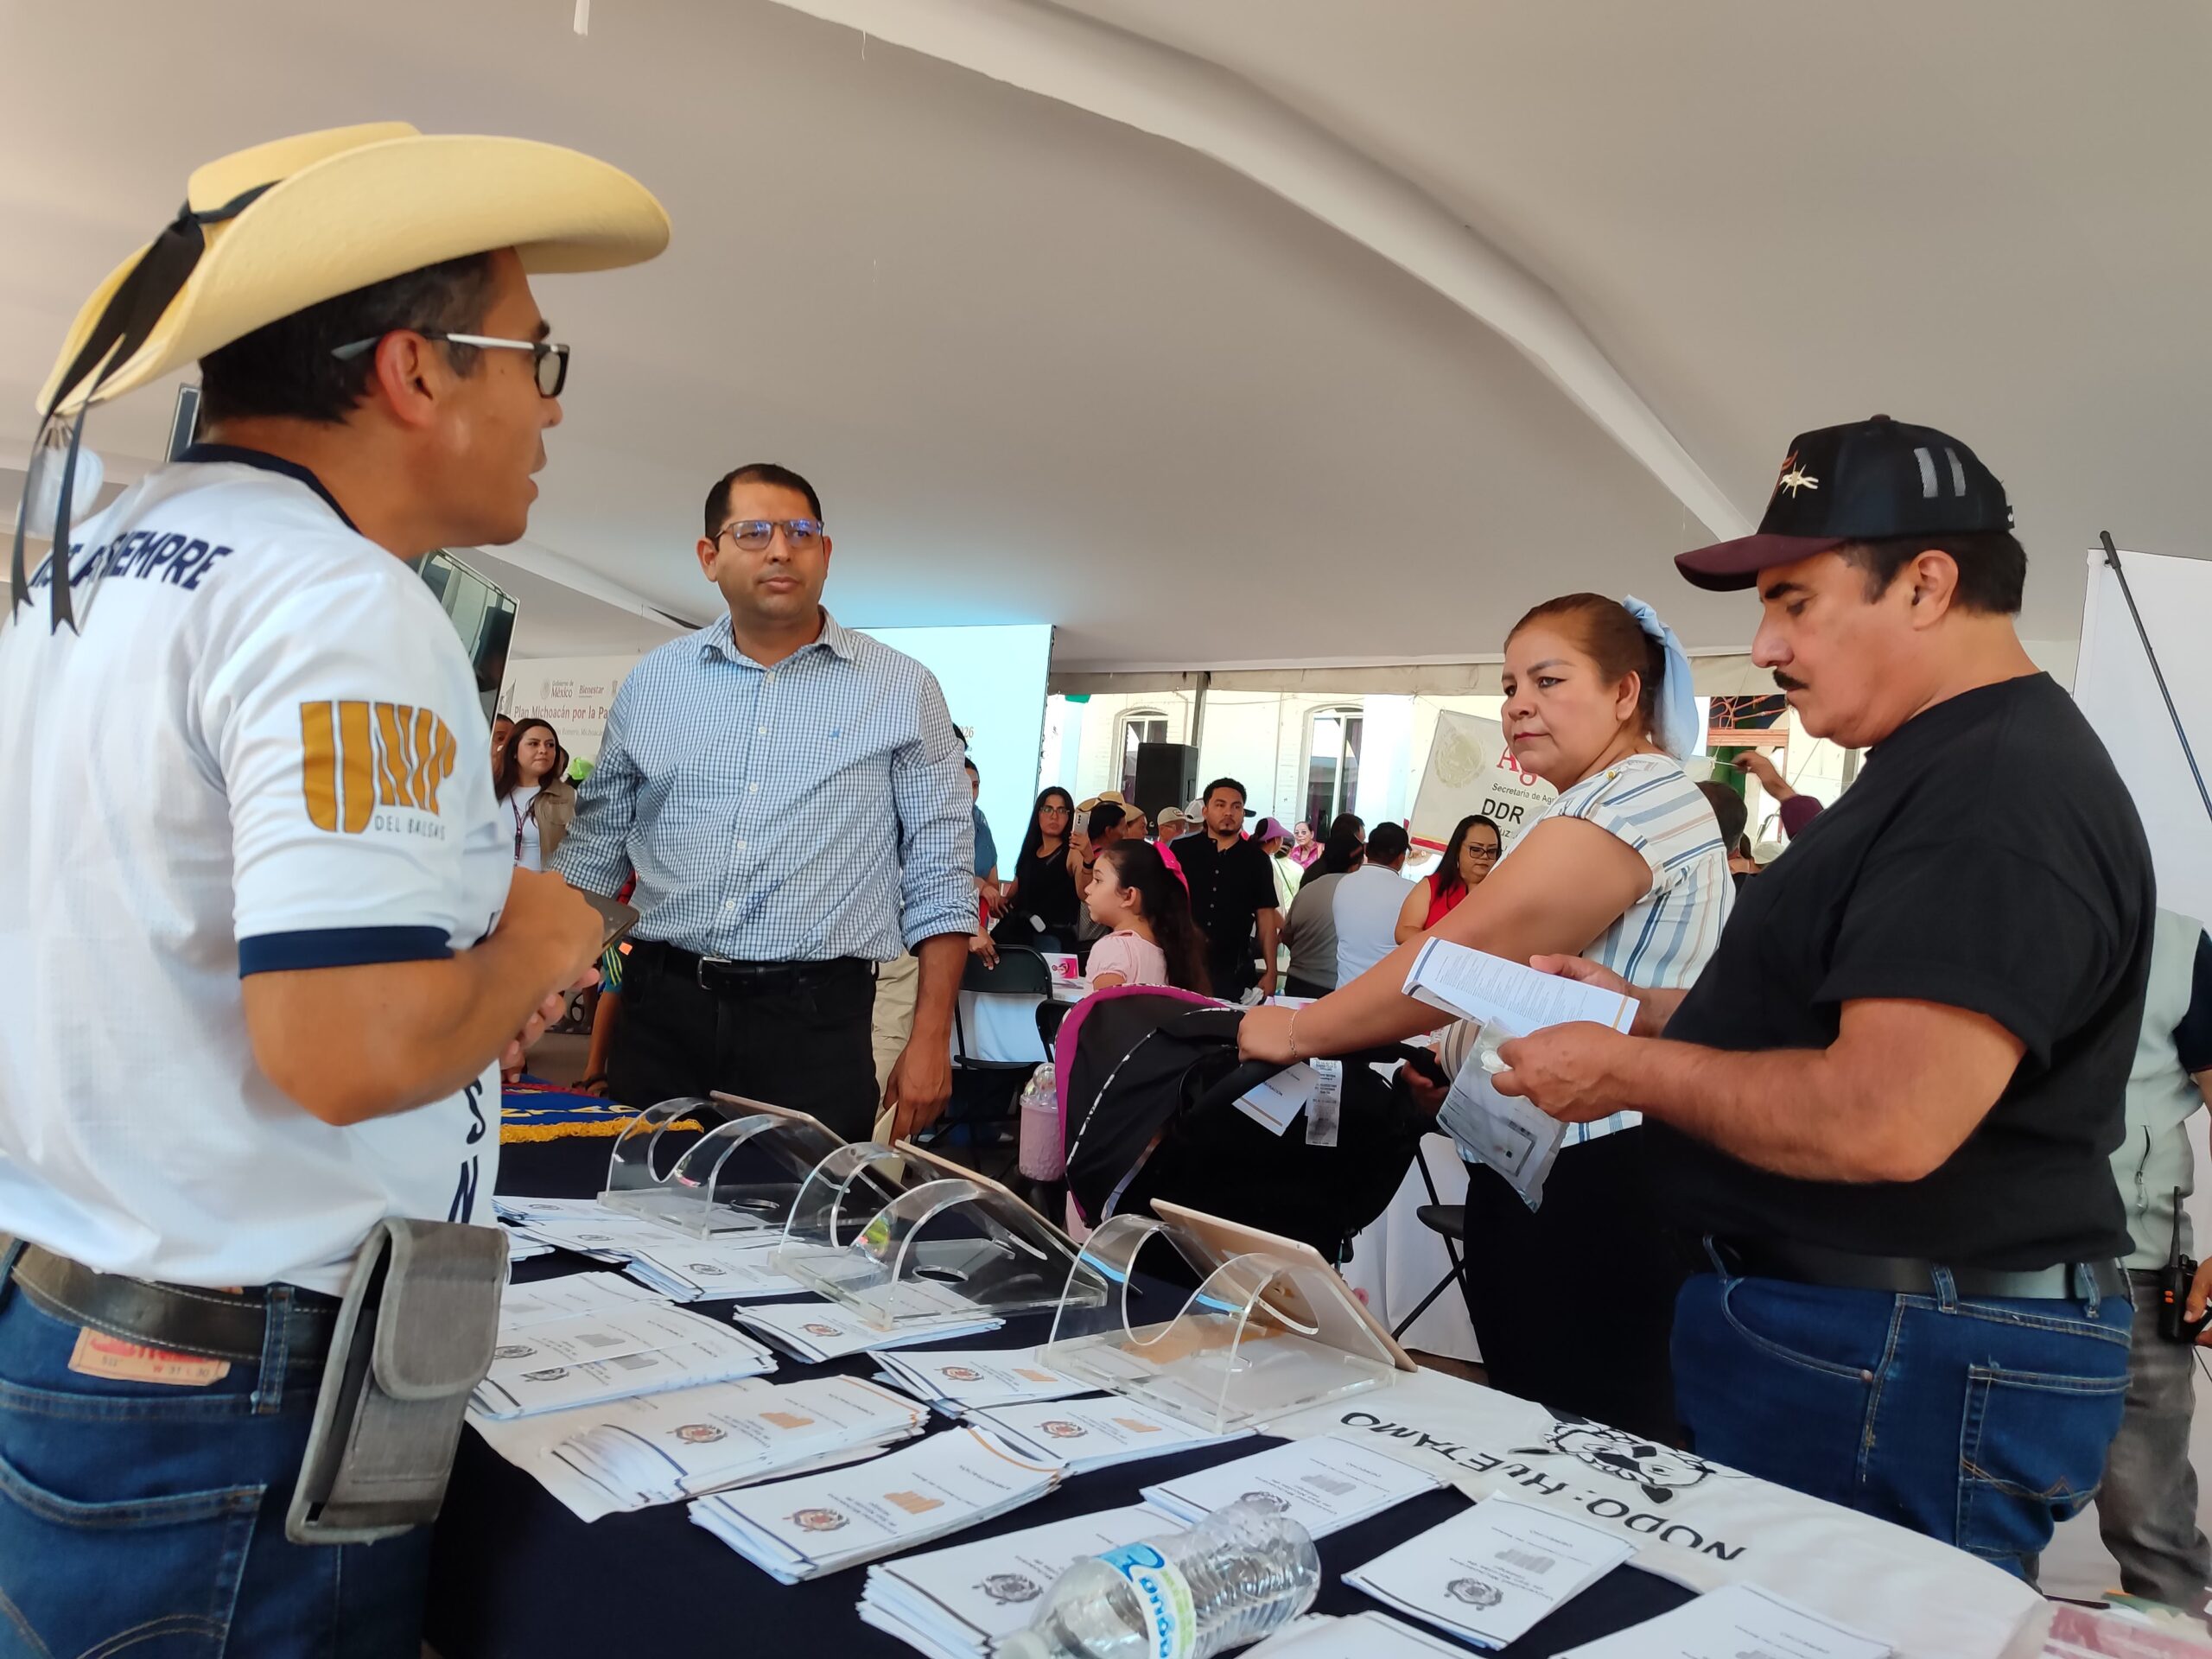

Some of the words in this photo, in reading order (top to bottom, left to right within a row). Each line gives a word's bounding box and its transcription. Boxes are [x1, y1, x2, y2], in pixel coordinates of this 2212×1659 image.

[551, 687, 574, 698] México
[579, 685, 605, 695] Bienestar
[514, 706, 529, 719] Plan
[531, 705, 569, 719] Michoacán
[572, 709, 586, 721] por
[588, 705, 596, 719] la
[598, 707, 608, 719] Pa
[1532, 792, 1541, 801] de
[1541, 795, 1556, 805] Agr
[1481, 798, 1524, 824] DDR
[374, 815, 400, 833] DEL
[1340, 1412, 1568, 1495] HUETAMO
